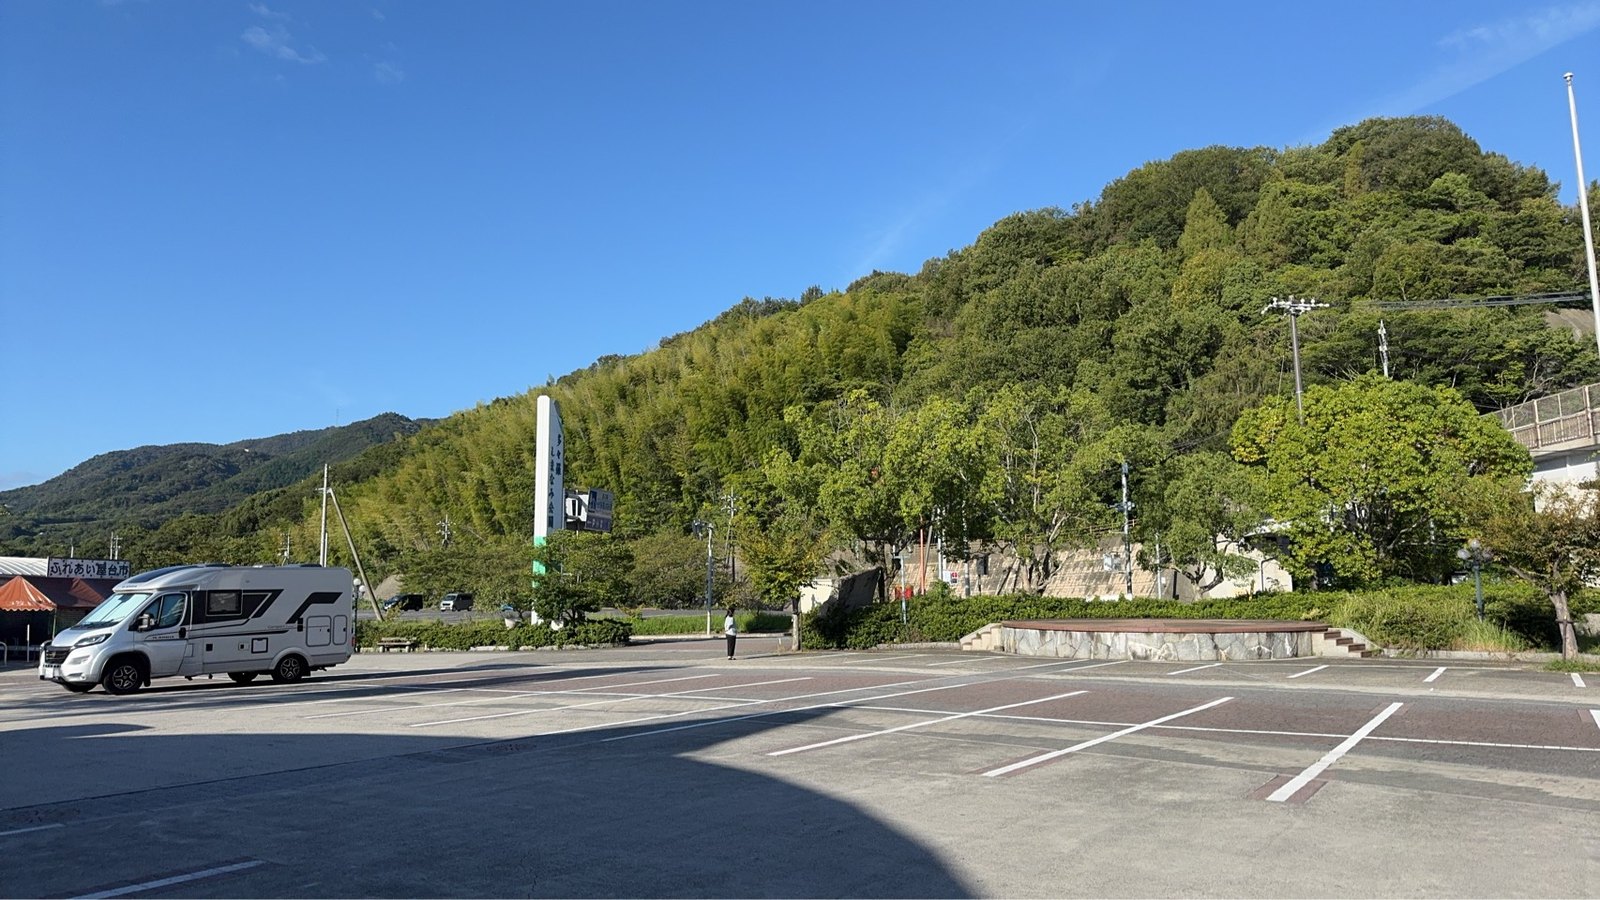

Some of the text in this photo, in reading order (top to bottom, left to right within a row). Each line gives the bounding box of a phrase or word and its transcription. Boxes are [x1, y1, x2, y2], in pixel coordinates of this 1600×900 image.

[50, 562, 129, 576] ふれあい屋台市
